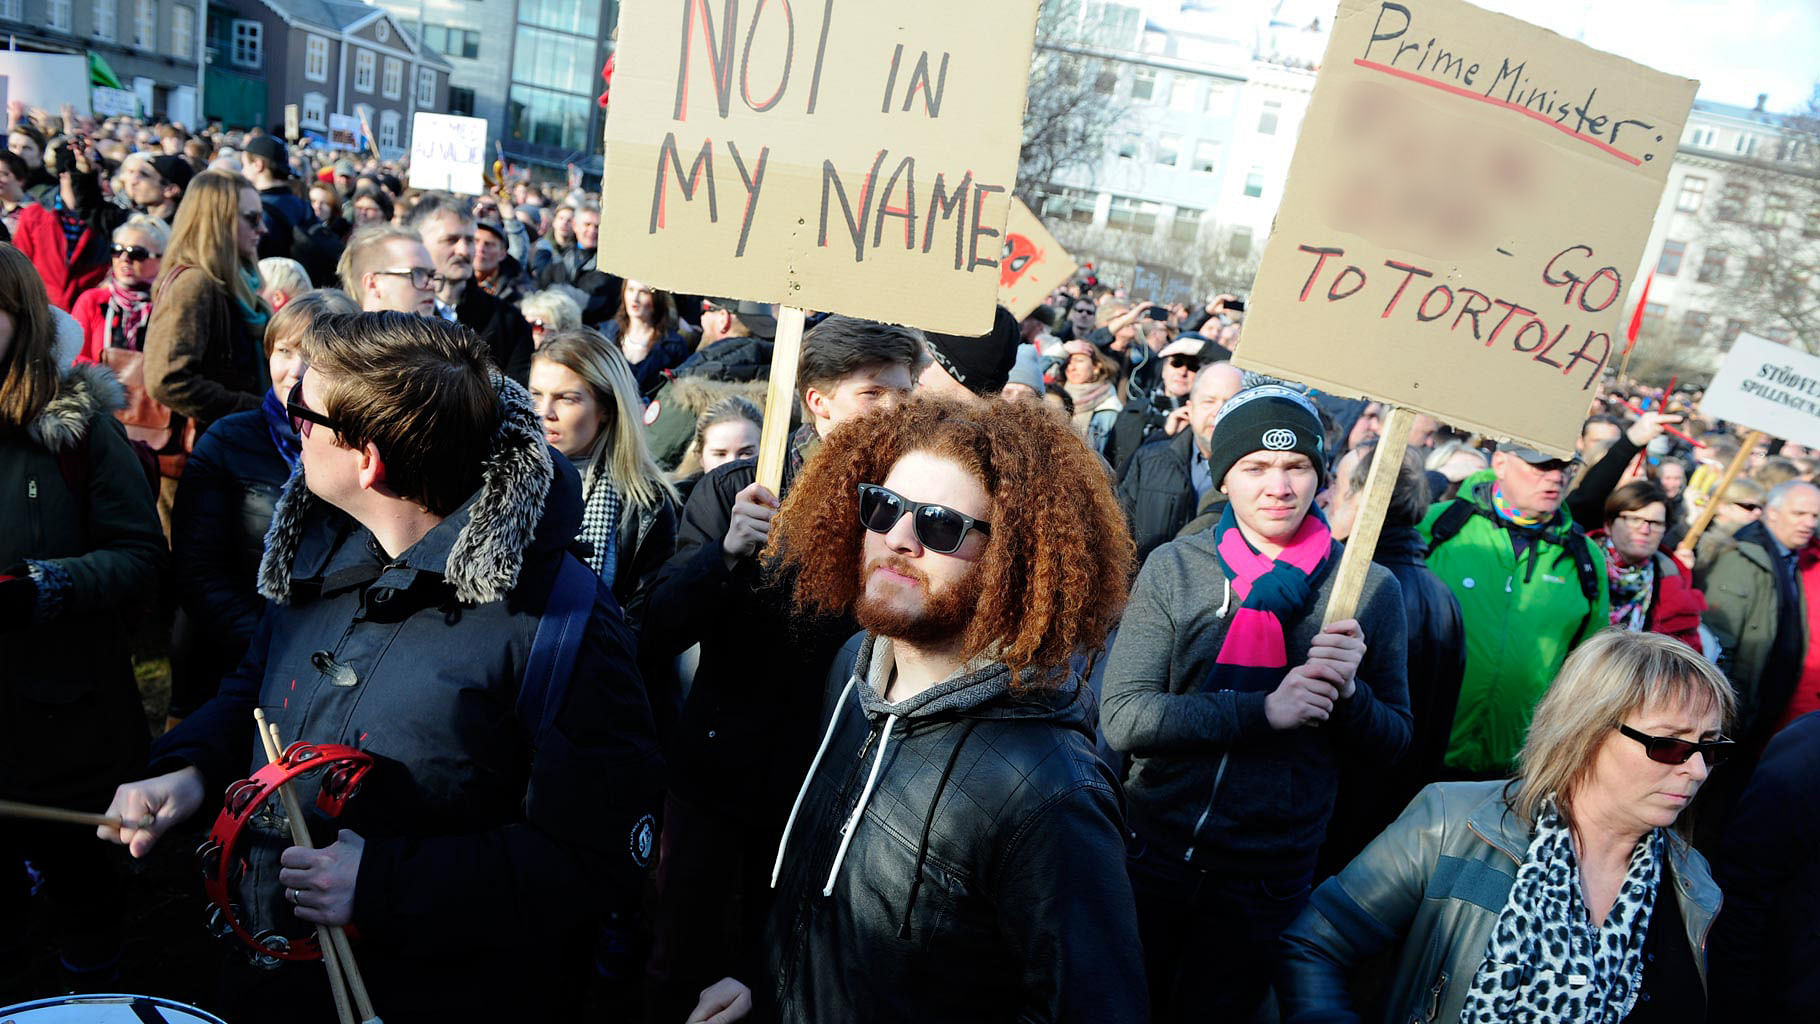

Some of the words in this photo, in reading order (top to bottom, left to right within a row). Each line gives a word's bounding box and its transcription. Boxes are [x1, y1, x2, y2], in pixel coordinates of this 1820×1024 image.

[881, 43, 950, 118] IN
[1364, 2, 1481, 87] Prime
[1484, 57, 1665, 161] Minister:
[648, 132, 769, 257] MY
[817, 149, 1006, 272] NAME
[1298, 243, 1367, 302] TO
[1381, 260, 1614, 390] TORTOLA
[1542, 244, 1622, 312] GO
